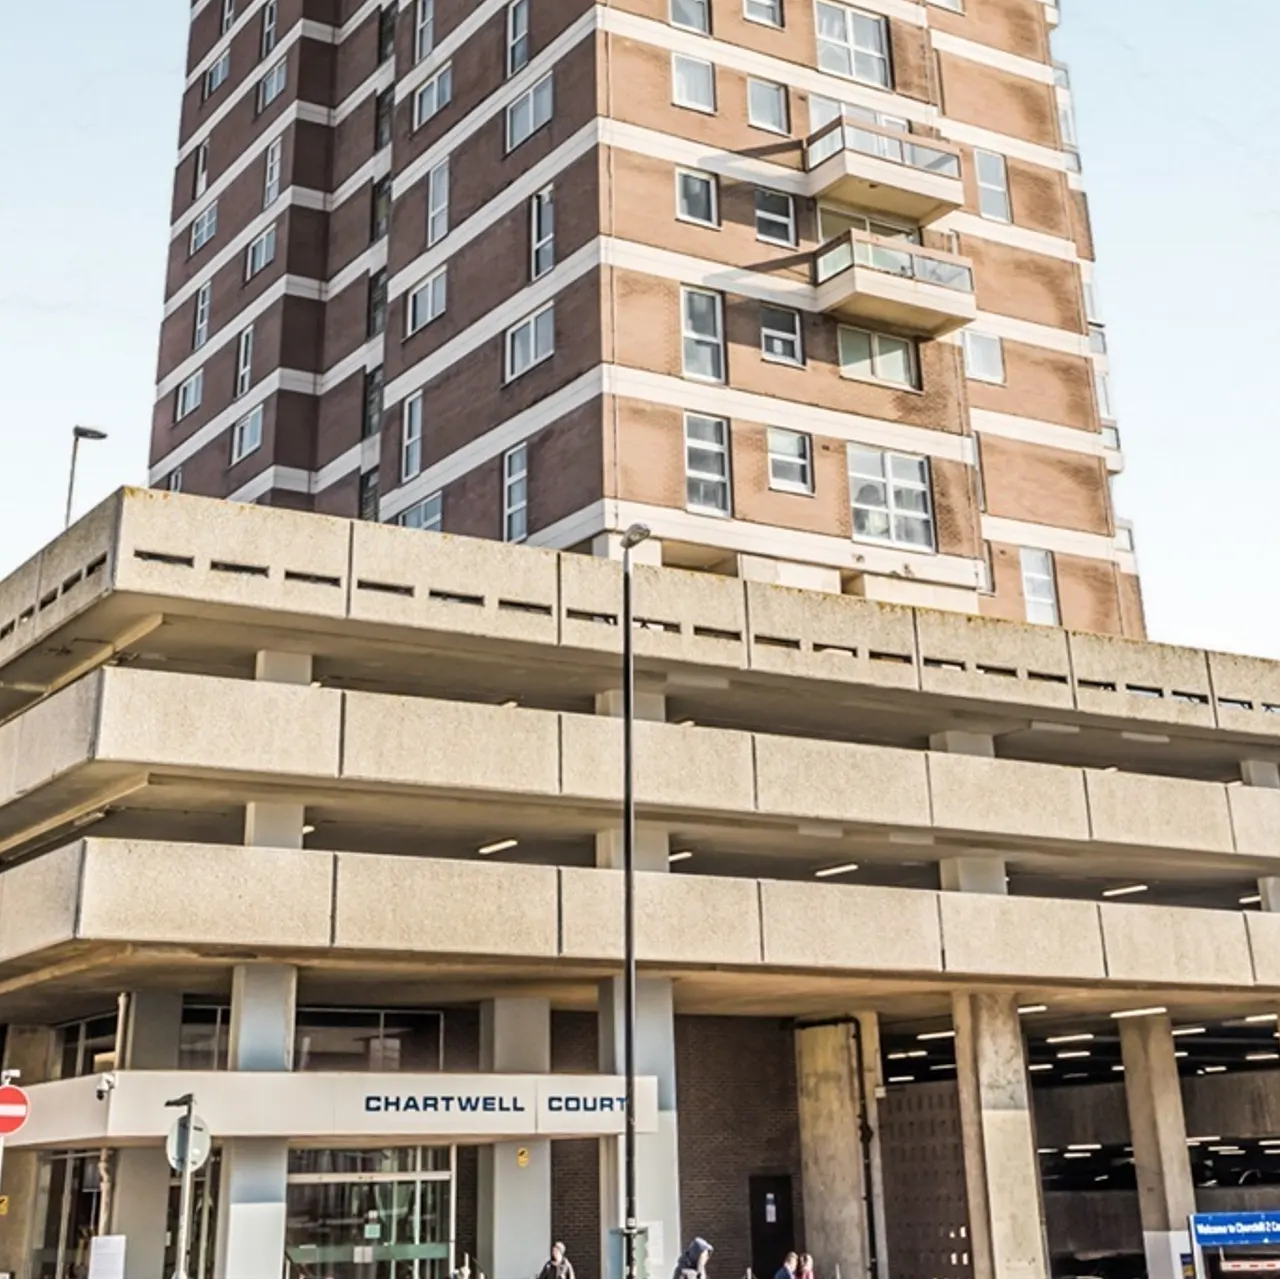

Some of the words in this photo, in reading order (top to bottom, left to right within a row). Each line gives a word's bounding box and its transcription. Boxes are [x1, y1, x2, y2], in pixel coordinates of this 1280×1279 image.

[364, 1095, 525, 1112] CHARTWELL
[547, 1096, 628, 1112] COURT
[1196, 1223, 1227, 1234] Welcome
